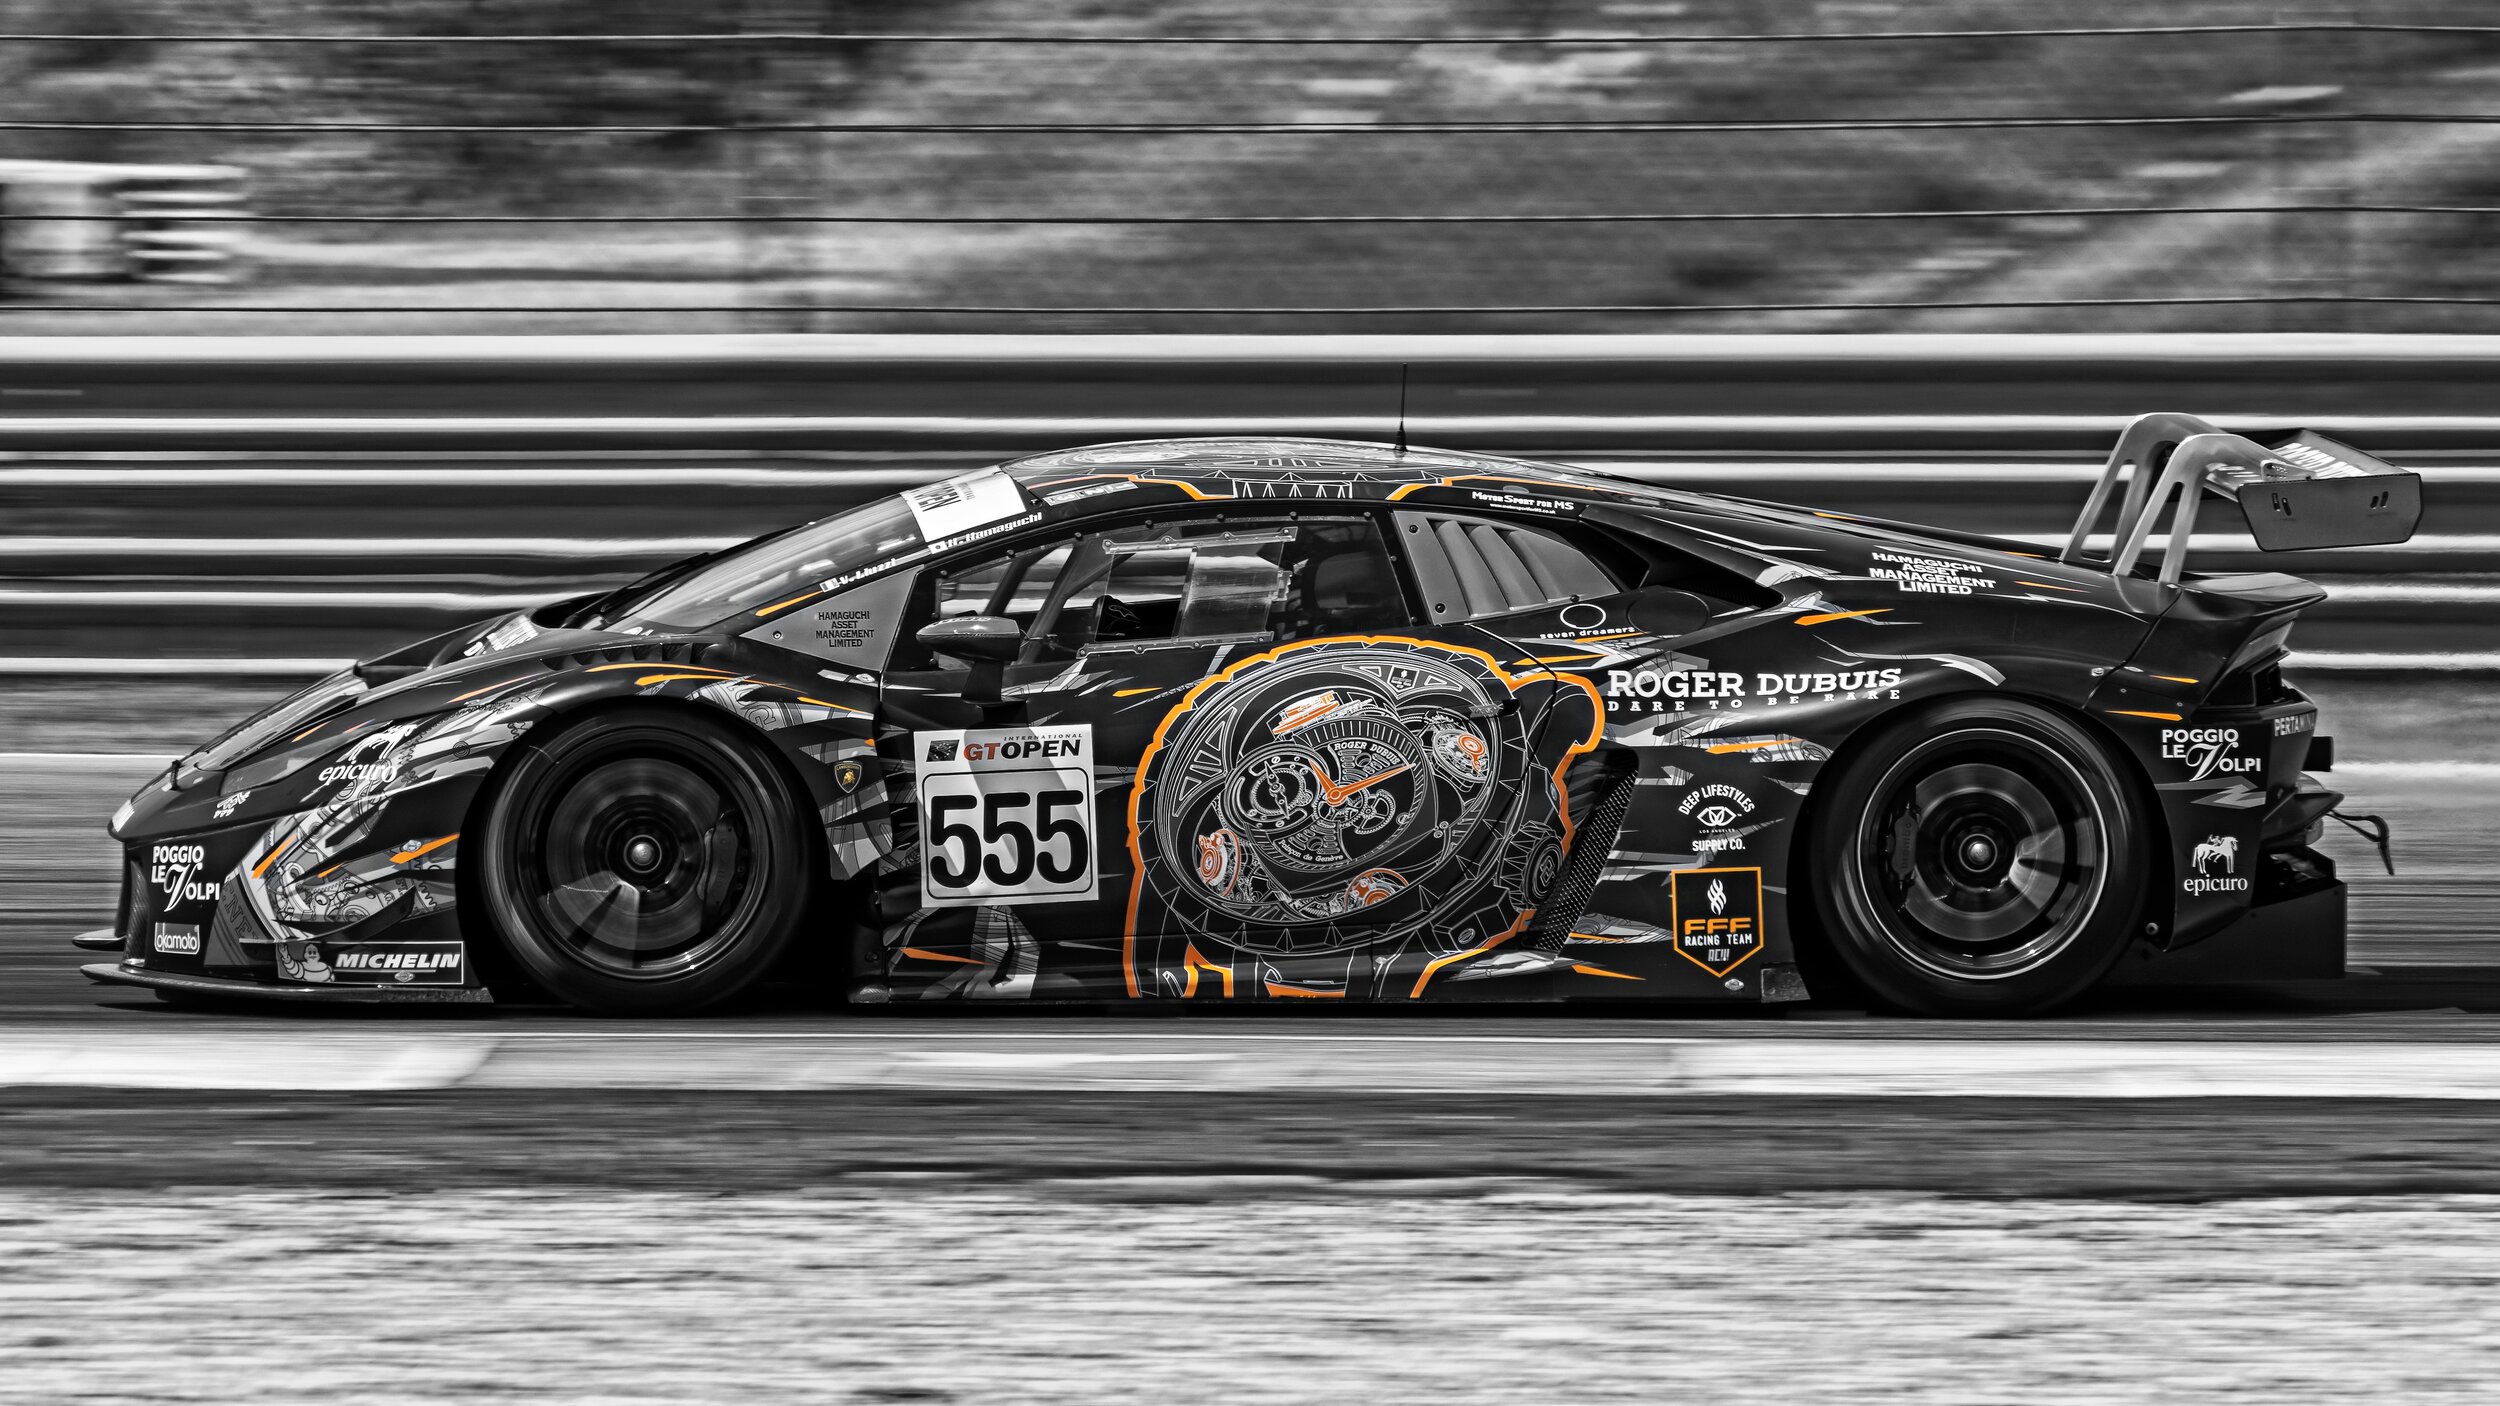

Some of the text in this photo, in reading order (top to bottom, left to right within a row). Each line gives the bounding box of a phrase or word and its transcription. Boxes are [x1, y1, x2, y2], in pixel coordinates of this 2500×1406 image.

[1554, 501, 1574, 510] MS
[1872, 552, 1983, 573] HAMAGUCHI
[1902, 563, 1959, 576] ASSET
[1869, 568, 1997, 588] MANAGEMENT
[1899, 580, 1972, 595] LIMITED
[818, 611, 870, 620] HAMAGUCHI
[831, 620, 858, 629] ASSET
[815, 629, 875, 639] MANAGEMENT
[1540, 626, 1635, 640] seven dreamers
[829, 639, 863, 648] LIMITED
[1607, 668, 1902, 698] ROGER DUBUIS
[1607, 689, 1900, 712] DARE TO BE RARE
[1003, 733, 1083, 742] INTERNATIONAL
[2162, 728, 2239, 743] POGGIO
[1333, 741, 1400, 765] ROGER DUBUIS
[2162, 741, 2261, 782] LE VOLPI
[318, 760, 397, 786] epicuro
[1678, 784, 1755, 816] DEEP LIFESTYLES
[929, 789, 1088, 889] 555
[1692, 838, 1746, 852] SUPPLY CO.
[152, 845, 205, 863] POGGIO
[151, 865, 166, 883] LE
[163, 862, 221, 912] VOLPI
[2183, 874, 2249, 897] epicuro
[1684, 917, 1752, 935] FFF
[156, 926, 198, 951] okamoto
[1684, 933, 1752, 947] RACING TEAM
[335, 953, 461, 969] MICHELIN
